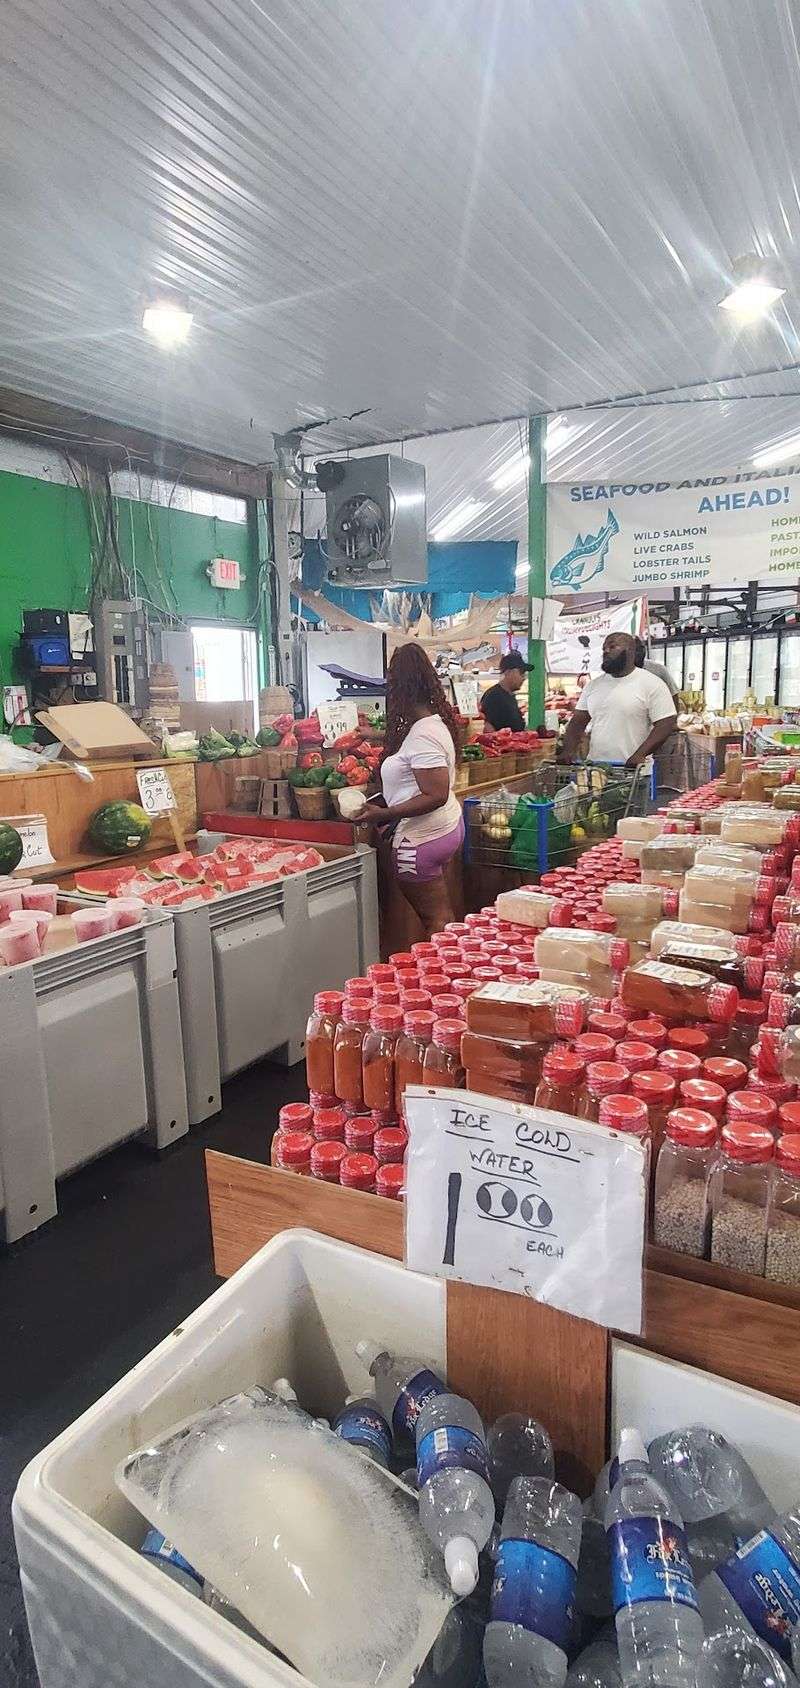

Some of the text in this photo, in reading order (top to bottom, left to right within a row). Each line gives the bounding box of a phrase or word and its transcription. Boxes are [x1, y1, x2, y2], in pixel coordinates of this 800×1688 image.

[570, 482, 671, 502] SEAFOOD
[676, 475, 728, 490] AND
[697, 486, 790, 513] AHEAD!
[634, 526, 707, 541] WILD SALMON
[770, 531, 800, 543] PAST
[634, 542, 694, 554] LIVE CRABS
[220, 561, 237, 580] EXIT
[633, 555, 711, 569] LOBSTER TAILS
[632, 569, 710, 583] JUMBO SHRIMP
[449, 1108, 572, 1152] ICE COLD
[469, 1148, 538, 1181] WATER
[526, 1240, 564, 1259] EACH
